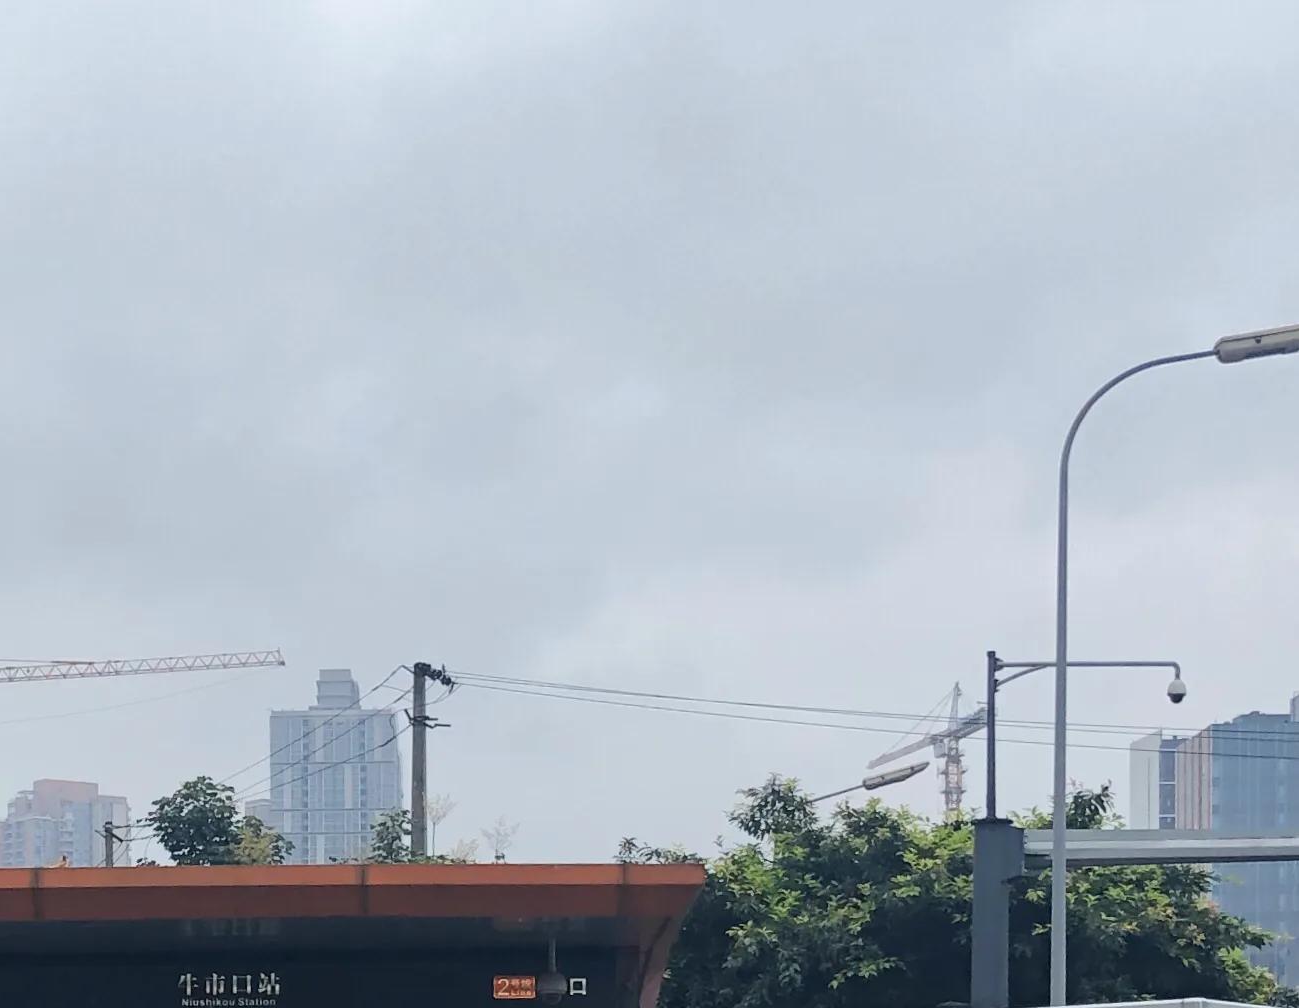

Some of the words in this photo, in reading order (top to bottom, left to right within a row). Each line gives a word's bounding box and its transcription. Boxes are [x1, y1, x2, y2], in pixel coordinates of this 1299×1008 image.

[178, 973, 281, 996] 牛市口站
[182, 998, 236, 1007] Niushikou
[237, 998, 277, 1007] Station
